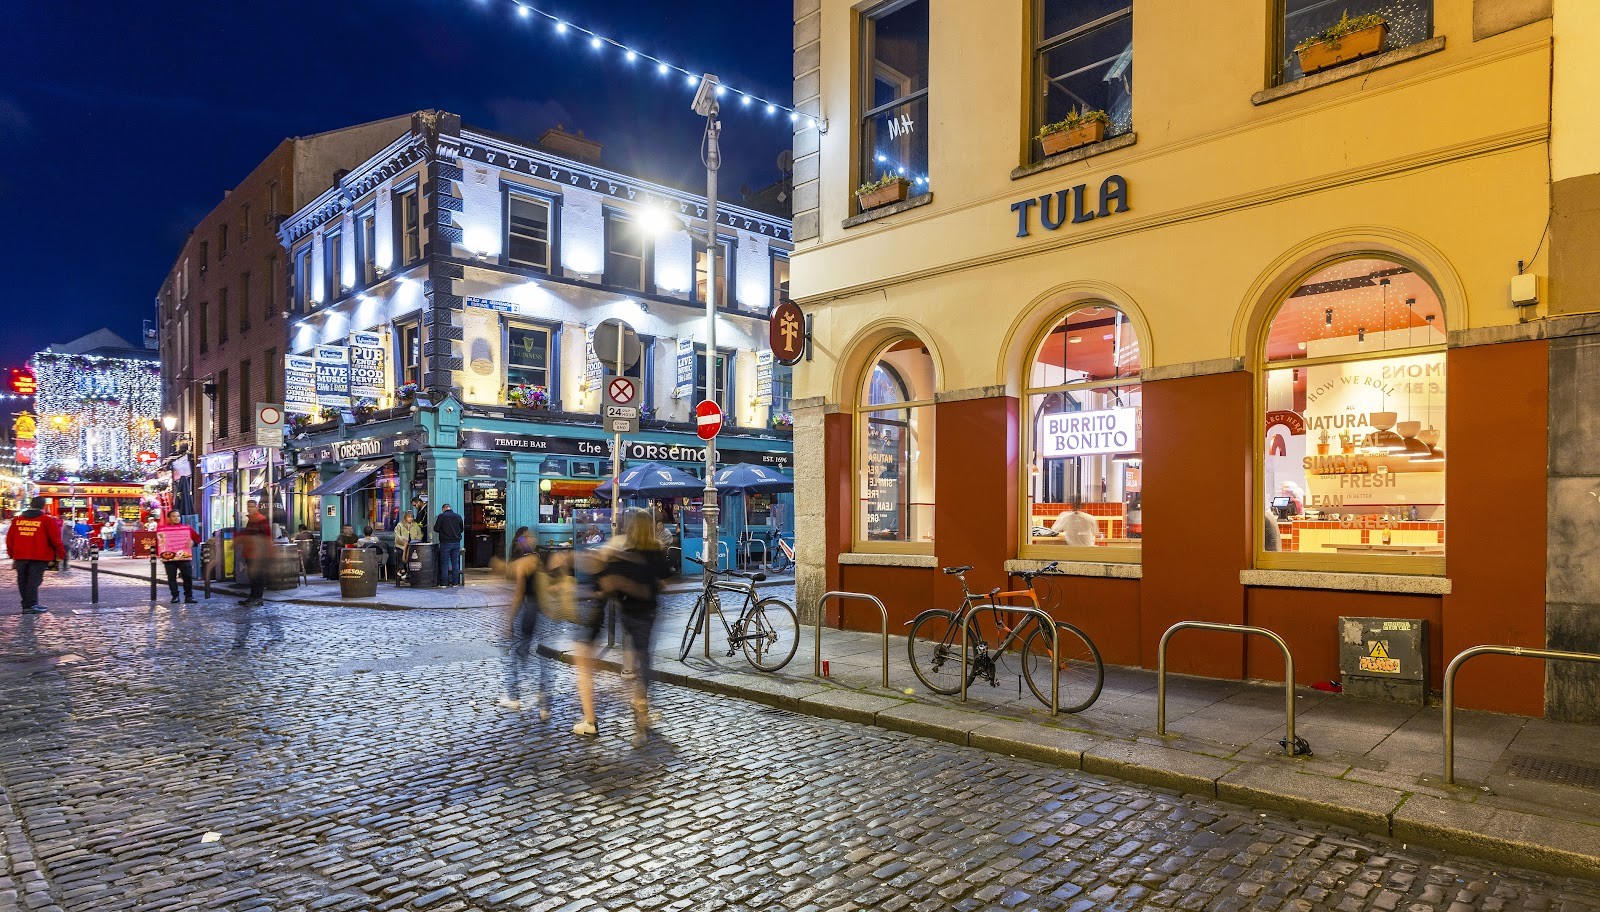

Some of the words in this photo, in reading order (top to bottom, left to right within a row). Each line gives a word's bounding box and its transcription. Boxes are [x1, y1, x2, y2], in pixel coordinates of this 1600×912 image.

[1010, 174, 1131, 238] TULA
[351, 347, 384, 361] PUB
[586, 362, 602, 371] FOOD
[678, 356, 693, 368] LIVE
[316, 365, 348, 377] LIVE
[351, 367, 384, 378] FOOD
[286, 375, 309, 383] LOCAL
[316, 375, 348, 384] MUSIC
[351, 376, 384, 384] SERVED
[1307, 379, 1335, 403] HOW
[1340, 375, 1360, 385] WE
[1364, 376, 1395, 397] ROLL
[609, 408, 622, 416] 24
[1049, 414, 1117, 435] BURRITO
[1266, 414, 1284, 427] LECT
[494, 438, 529, 449] TEMPLE
[530, 440, 547, 449] BAR
[1055, 430, 1128, 451] BONITO
[578, 441, 602, 454] The
[1302, 453, 1365, 470] SIMPLE
[1340, 472, 1396, 489] FRESH
[1303, 494, 1344, 508] LEAN
[1340, 513, 1399, 529] GREEN
